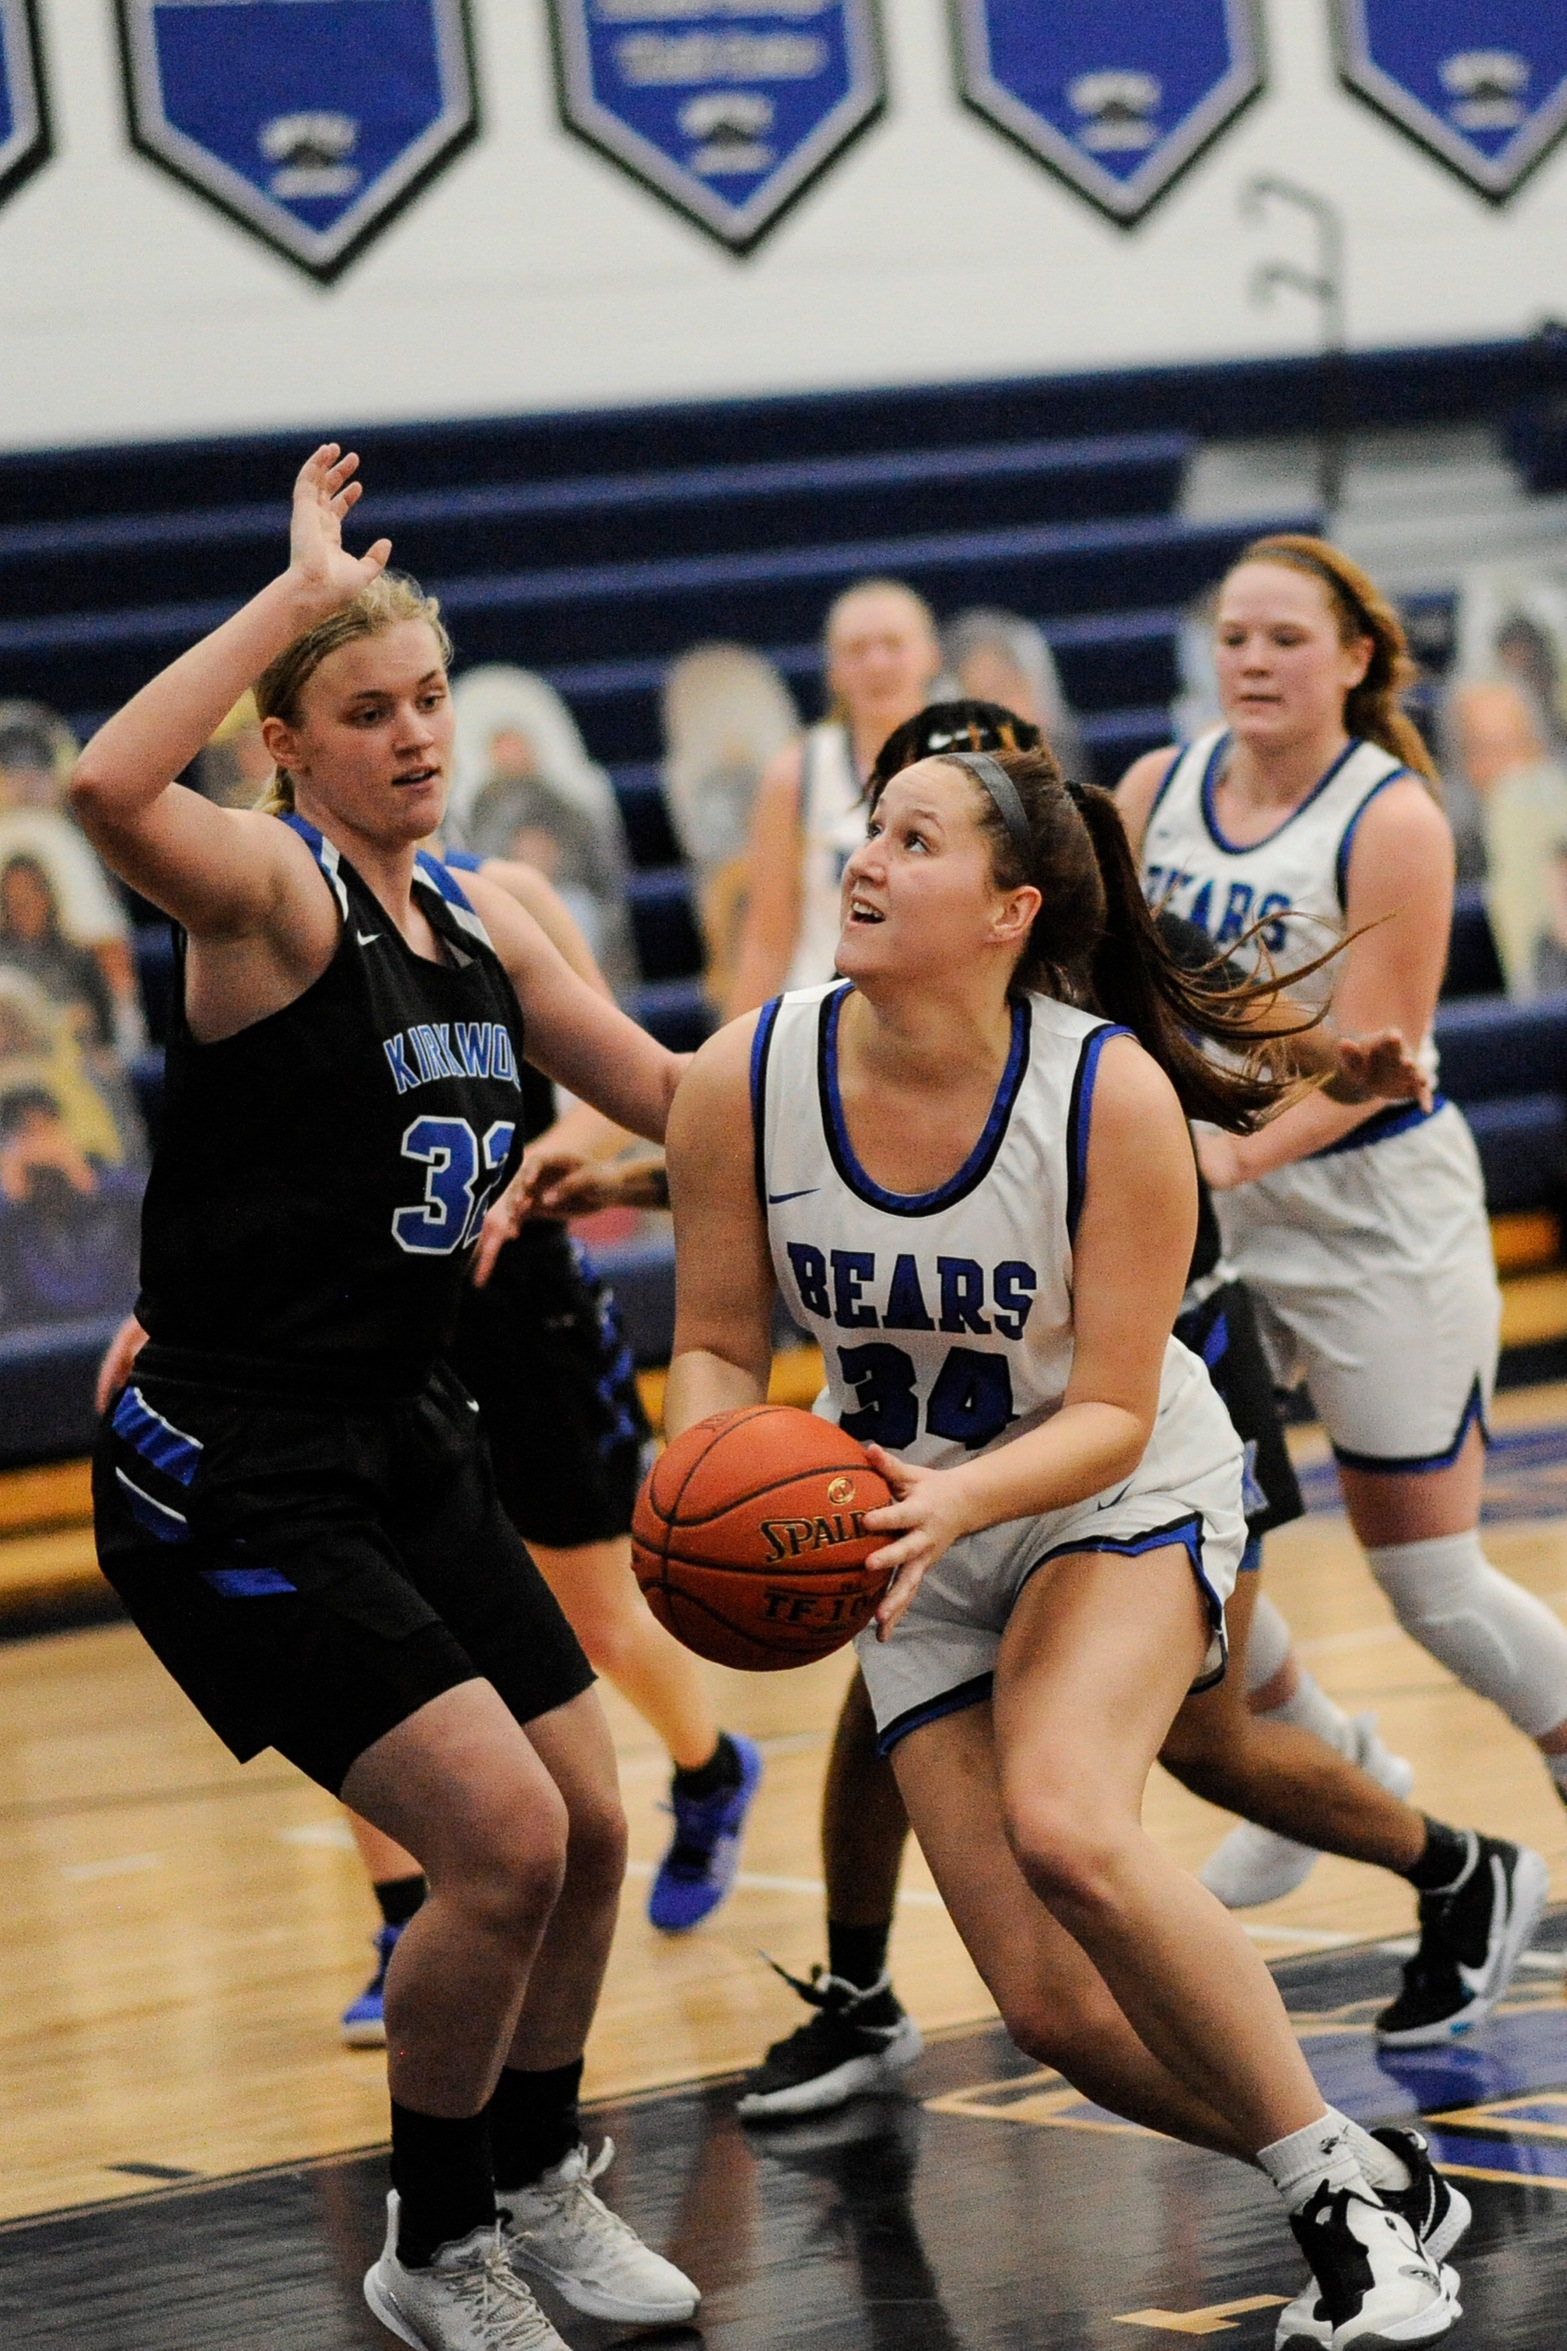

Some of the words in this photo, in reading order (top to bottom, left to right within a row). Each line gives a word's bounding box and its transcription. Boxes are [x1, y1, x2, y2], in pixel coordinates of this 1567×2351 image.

[383, 1022, 521, 1095] KIRKWO
[786, 1241, 1036, 1340] BEARS
[836, 1342, 1021, 1451] 34
[760, 1510, 872, 1562] SPALD
